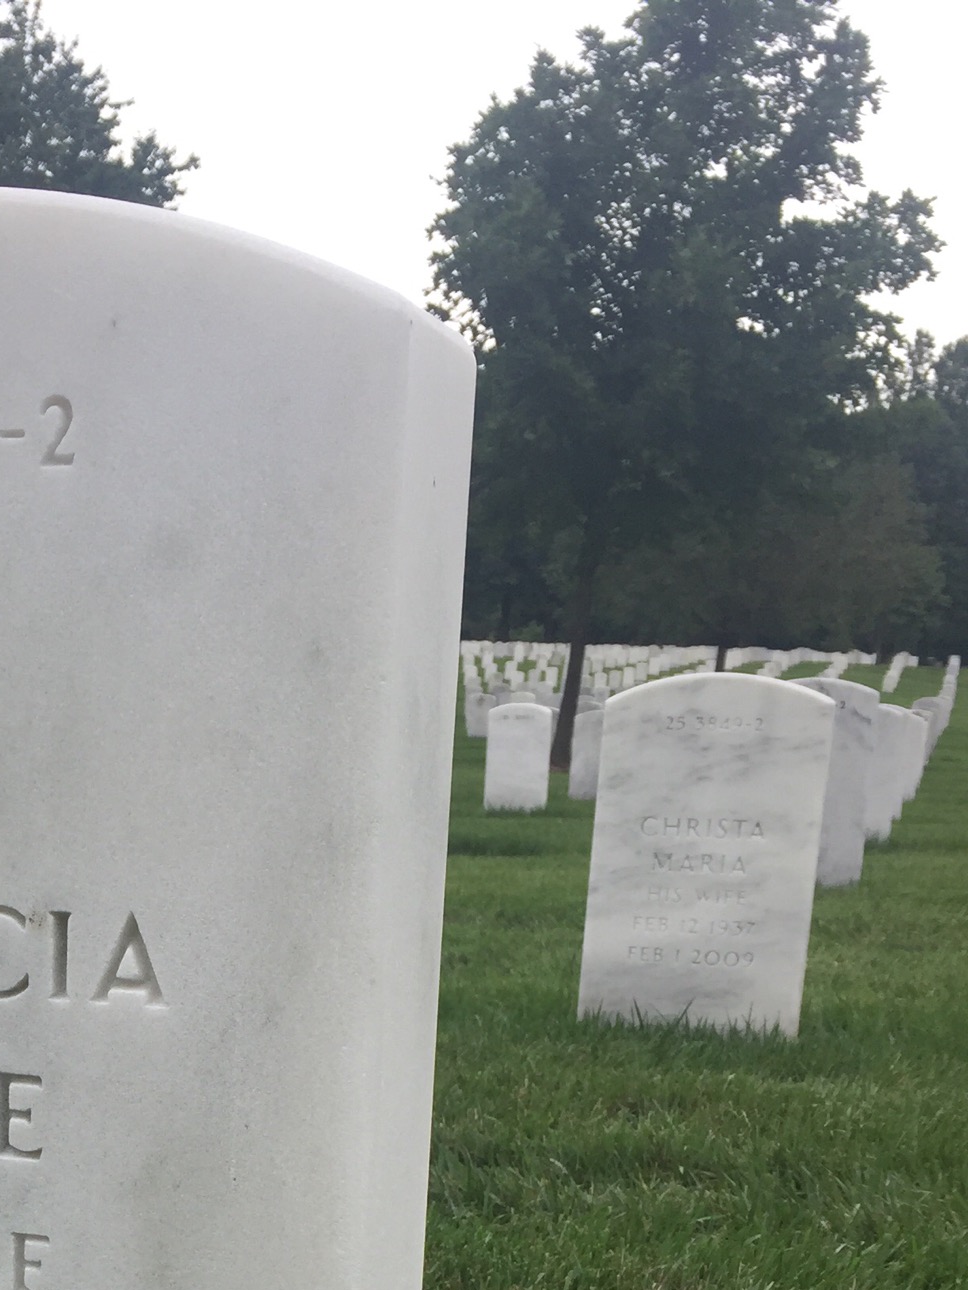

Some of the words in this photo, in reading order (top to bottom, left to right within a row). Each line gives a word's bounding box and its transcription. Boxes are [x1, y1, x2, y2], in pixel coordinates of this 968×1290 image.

[665, 715, 686, 731] 25
[640, 815, 764, 840] CHRISTA
[652, 851, 746, 875] MARIA
[648, 886, 681, 903] HIS
[695, 887, 746, 906] WIFE
[632, 915, 668, 932] FEB
[628, 944, 664, 962] FEB
[691, 948, 754, 968] 2009
